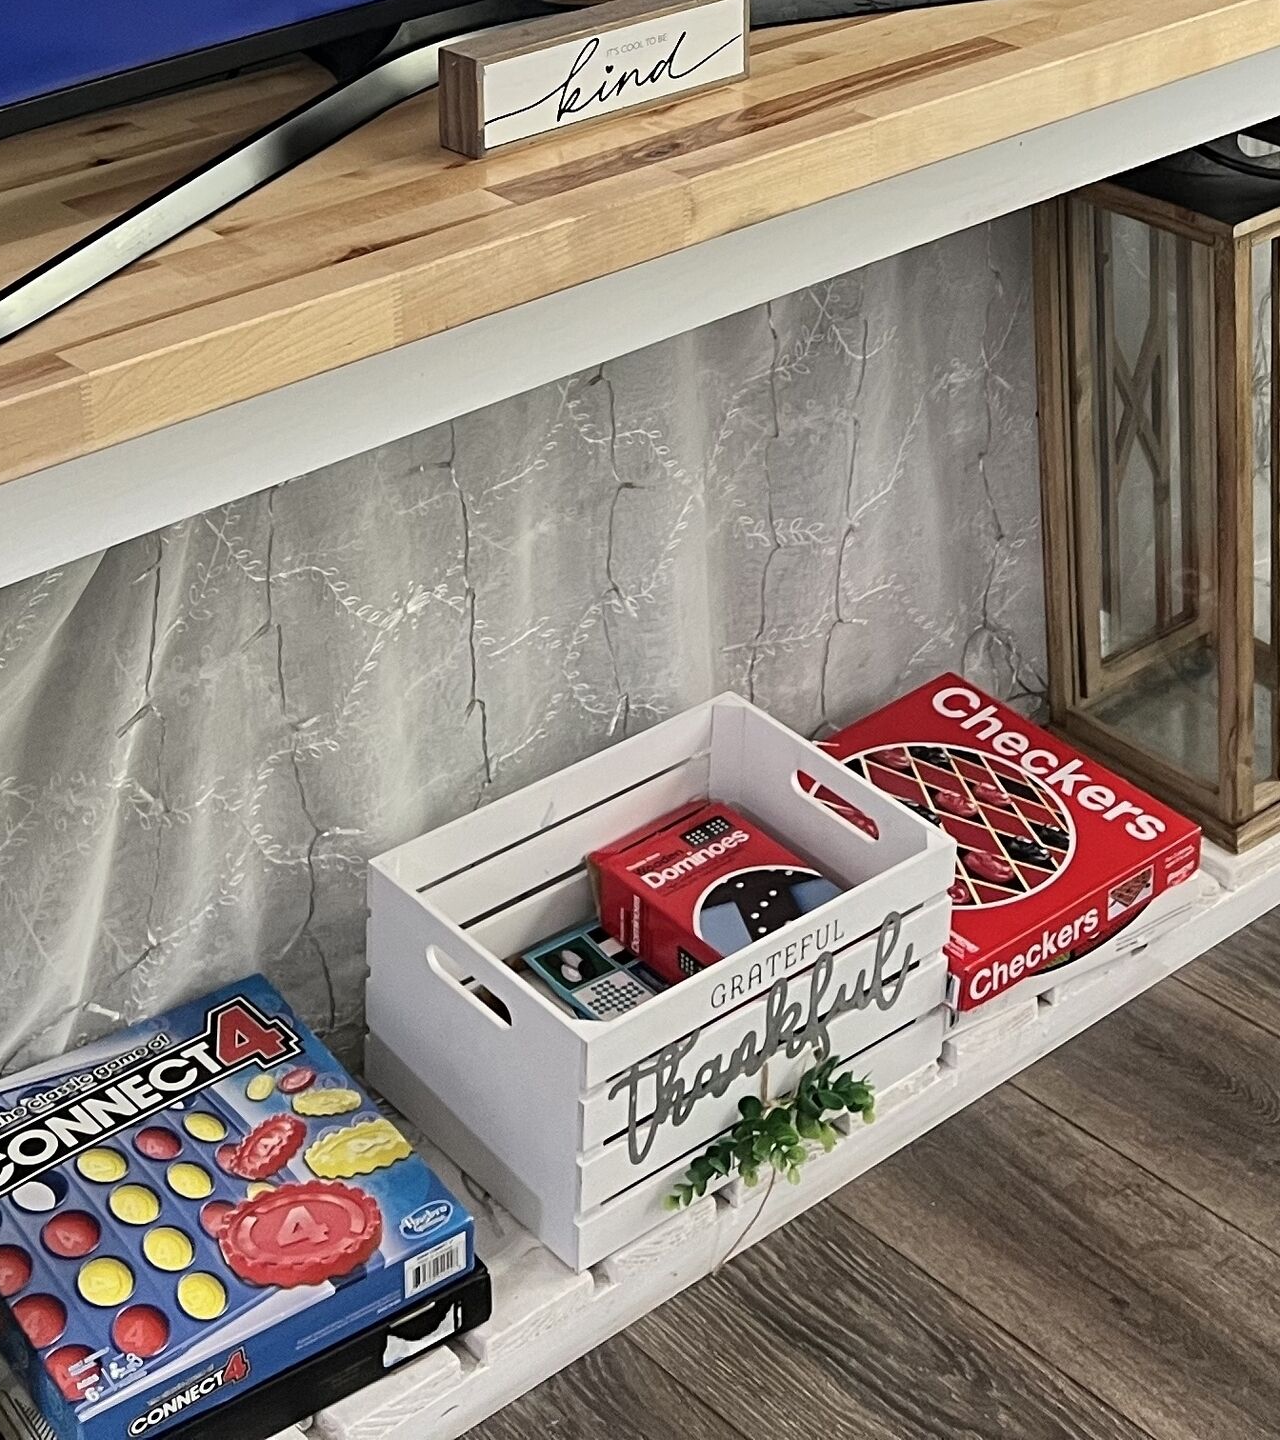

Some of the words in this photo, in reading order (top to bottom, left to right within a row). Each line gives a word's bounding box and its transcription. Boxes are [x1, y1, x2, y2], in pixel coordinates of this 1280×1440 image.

[620, 40, 644, 54] COOL
[645, 36, 657, 47] TO
[657, 32, 668, 44] BE
[932, 686, 1168, 842] Checkers
[640, 829, 750, 890] Dominoes
[709, 918, 846, 1010] GRATEFUL
[968, 907, 1100, 1002] Checkers
[216, 1005, 288, 1067] 4
[27, 1072, 94, 1114] classic
[93, 1047, 149, 1080] game
[130, 1370, 224, 1436] CONNECT
[223, 1347, 250, 1384] 4
